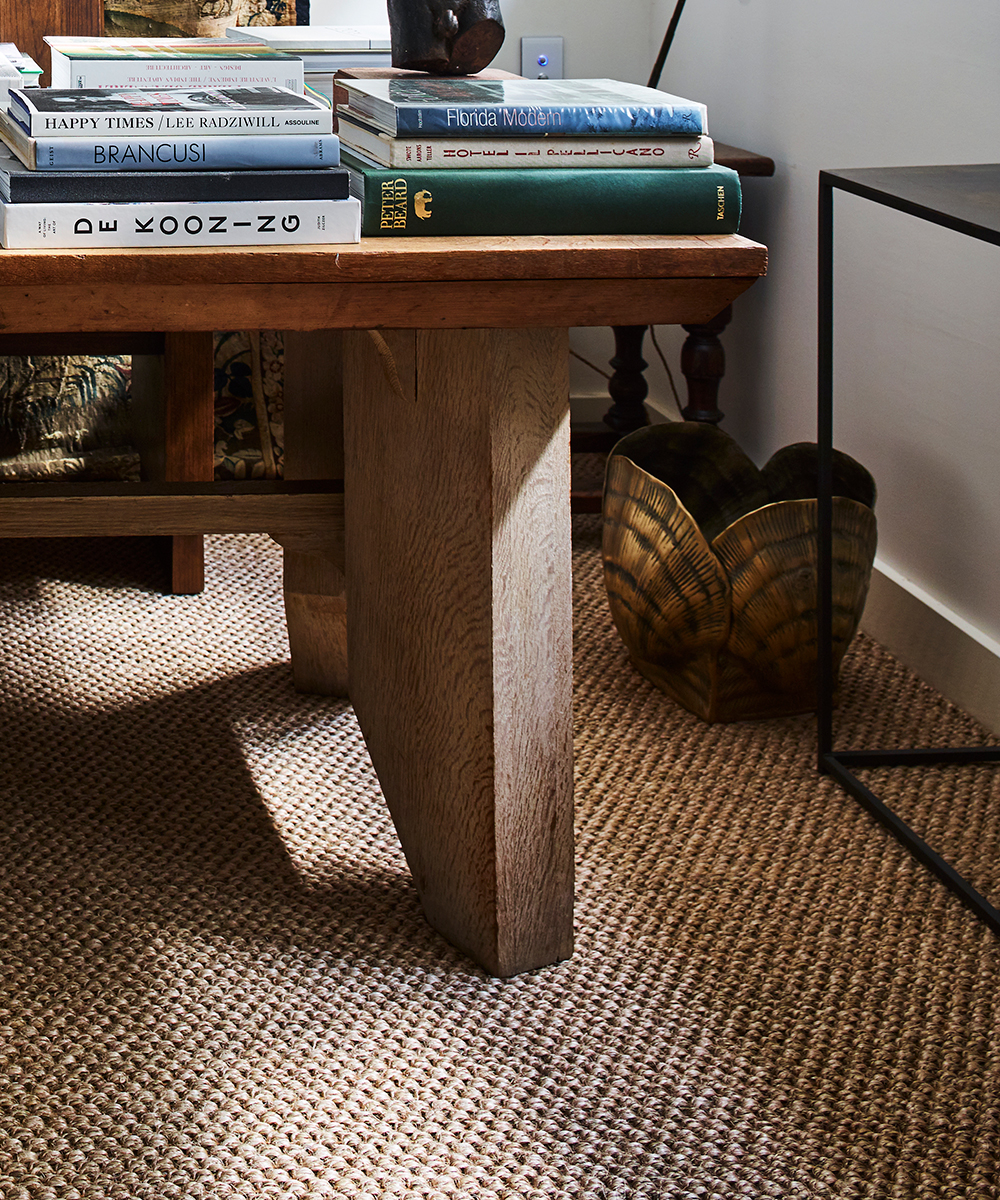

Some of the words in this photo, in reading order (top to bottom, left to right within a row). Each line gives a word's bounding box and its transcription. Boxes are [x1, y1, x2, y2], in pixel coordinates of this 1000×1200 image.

[45, 117, 101, 130] HAPPY
[105, 117, 154, 129] TIMES
[200, 116, 281, 128] RADZIWILL
[446, 108, 498, 127] Florida
[502, 108, 563, 127] Modern
[93, 142, 206, 164] BRANCUSI
[443, 149, 509, 157] HOTEL
[547, 147, 665, 156] PELLICANO
[380, 179, 394, 230] PETER
[393, 178, 408, 230] BEARD
[716, 185, 725, 221] TASCHEN
[74, 218, 118, 234] DE
[134, 215, 300, 236] KOONING
